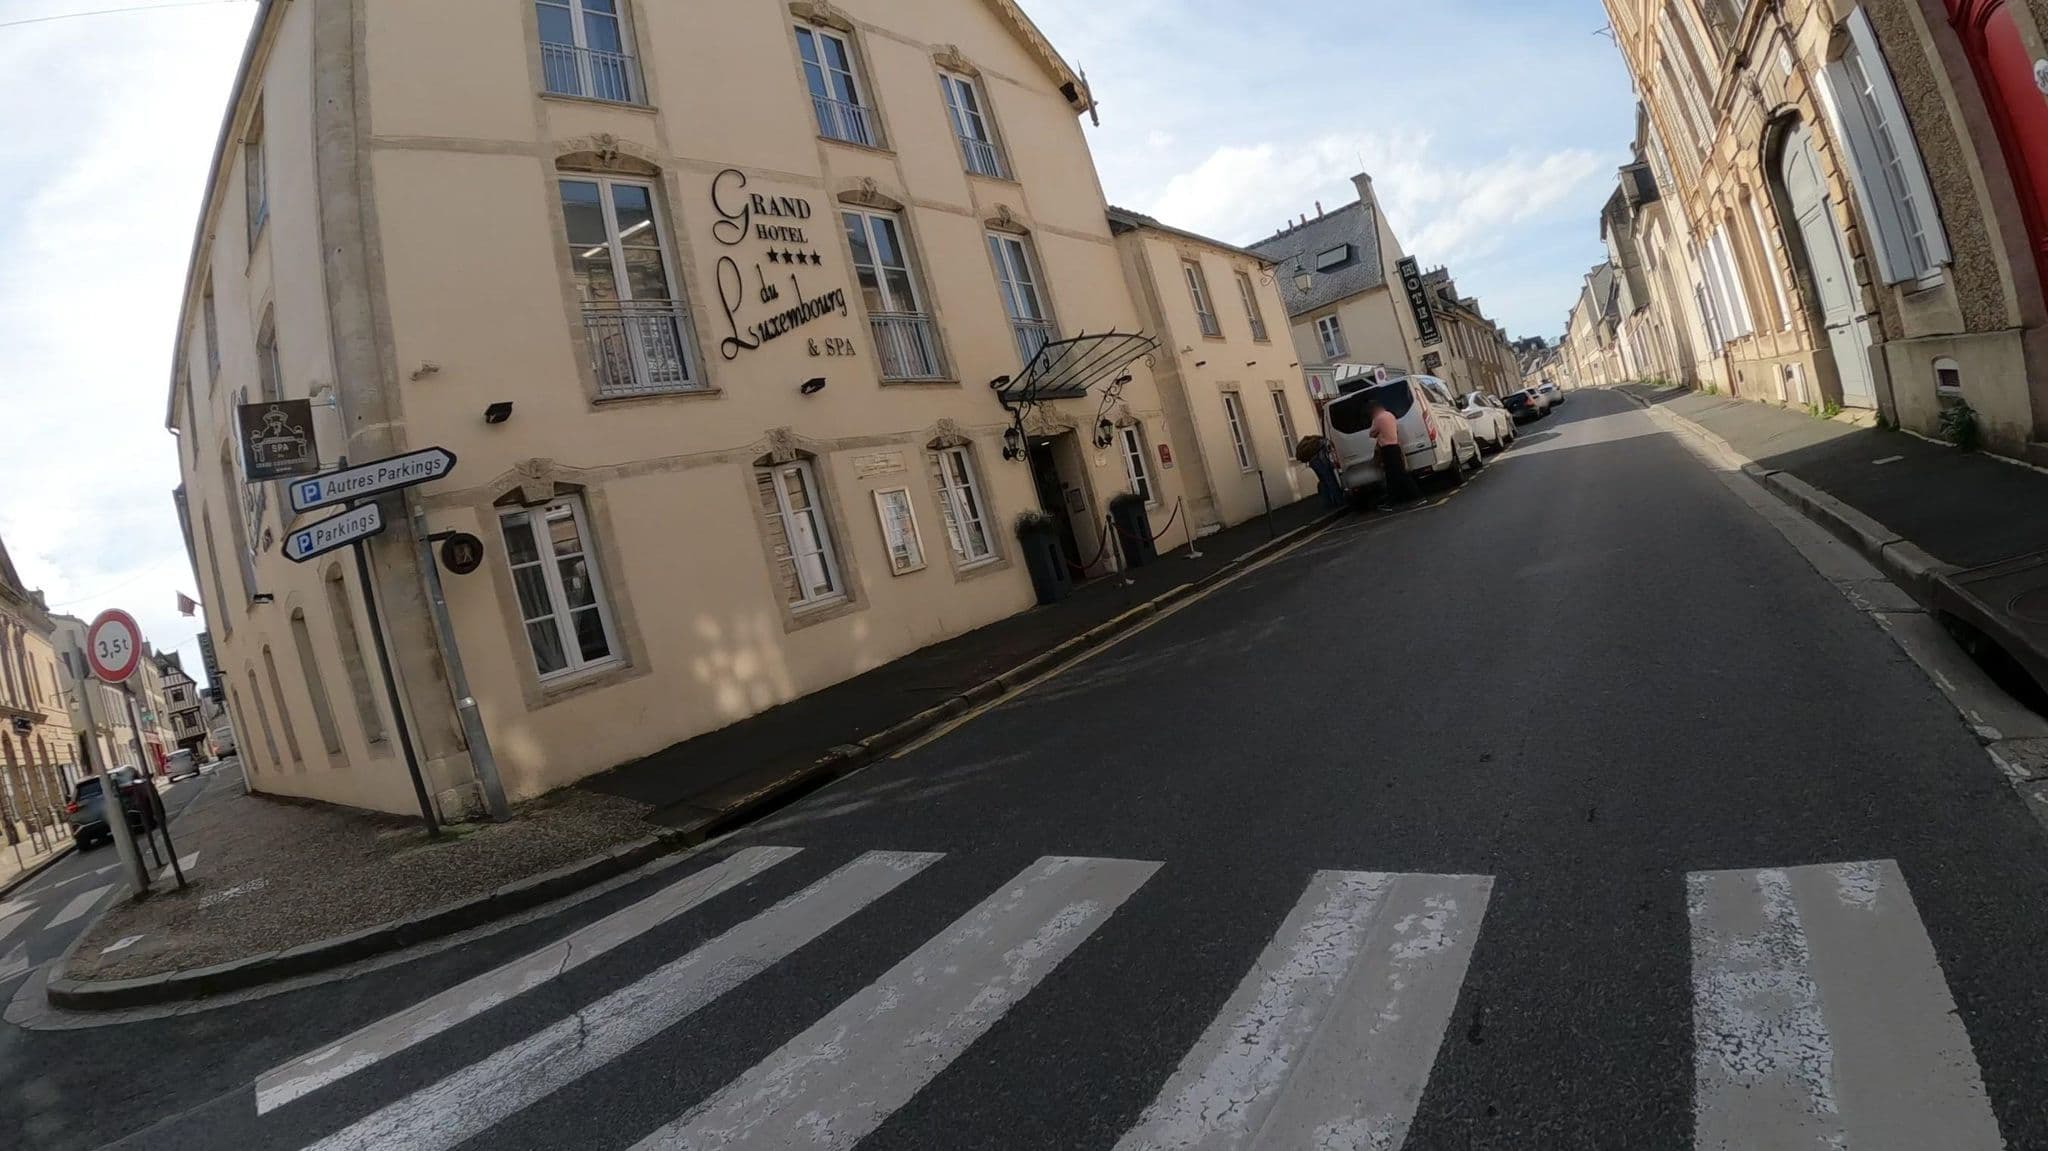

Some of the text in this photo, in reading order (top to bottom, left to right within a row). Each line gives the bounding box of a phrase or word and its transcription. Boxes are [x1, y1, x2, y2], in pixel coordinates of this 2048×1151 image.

[756, 223, 808, 243] HOTEL
[756, 263, 779, 303] du
[1401, 262, 1433, 333] HOTEL
[717, 255, 847, 360] Luxembourg
[807, 337, 856, 357] & SPA
[326, 474, 374, 496] Autres
[378, 458, 441, 482] Parkings
[316, 513, 375, 545] Parkings
